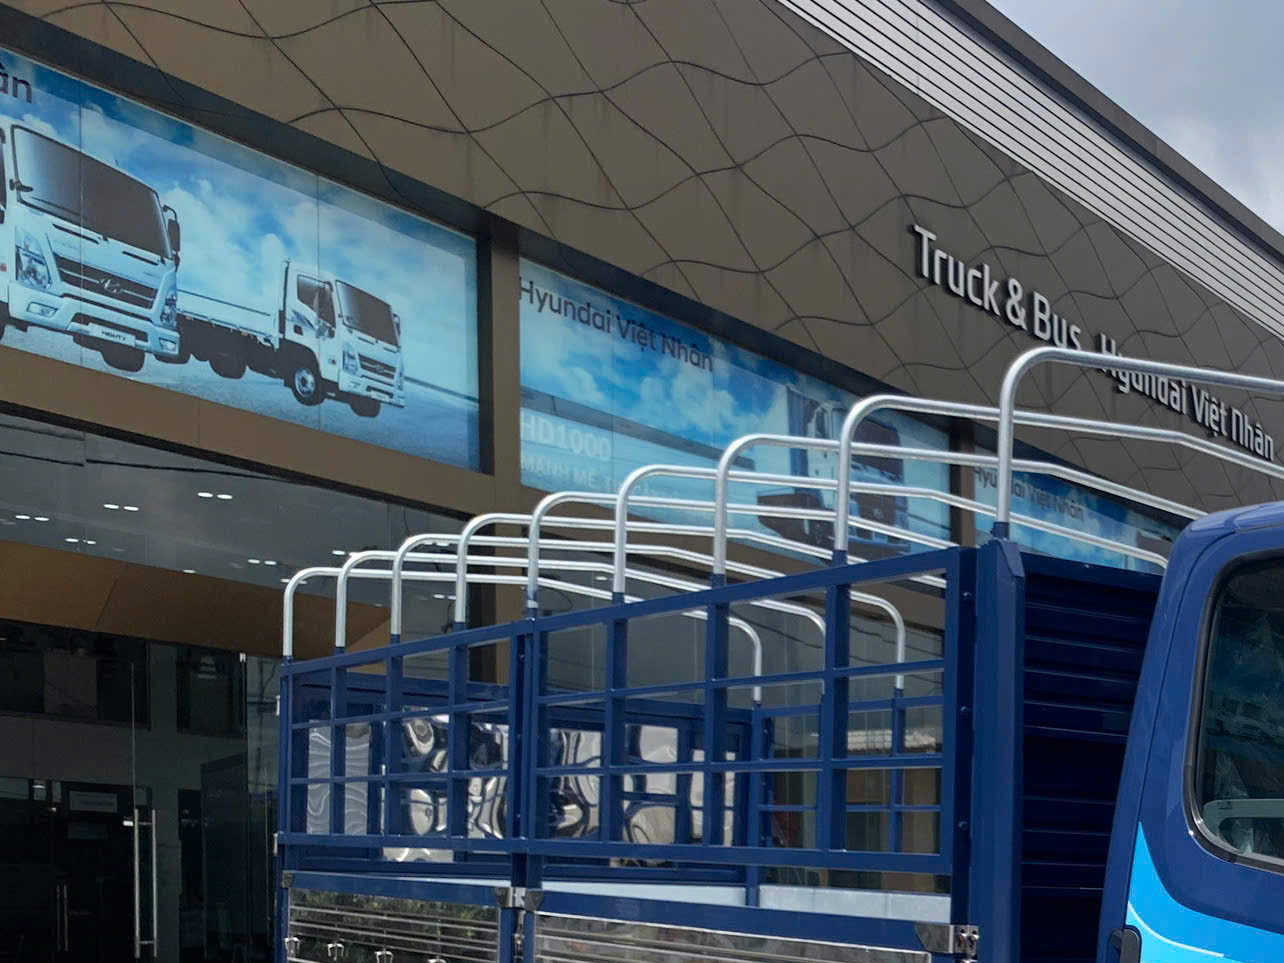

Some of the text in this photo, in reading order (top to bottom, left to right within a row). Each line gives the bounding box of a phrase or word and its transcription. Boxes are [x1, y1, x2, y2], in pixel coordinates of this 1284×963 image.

[520, 277, 713, 371] Hyundai Việt Nhân
[912, 225, 1000, 317] Truck
[1005, 277, 1028, 332] &
[1034, 290, 1081, 350] Bus
[1191, 384, 1228, 437] Việt
[1231, 407, 1274, 461] Nhân
